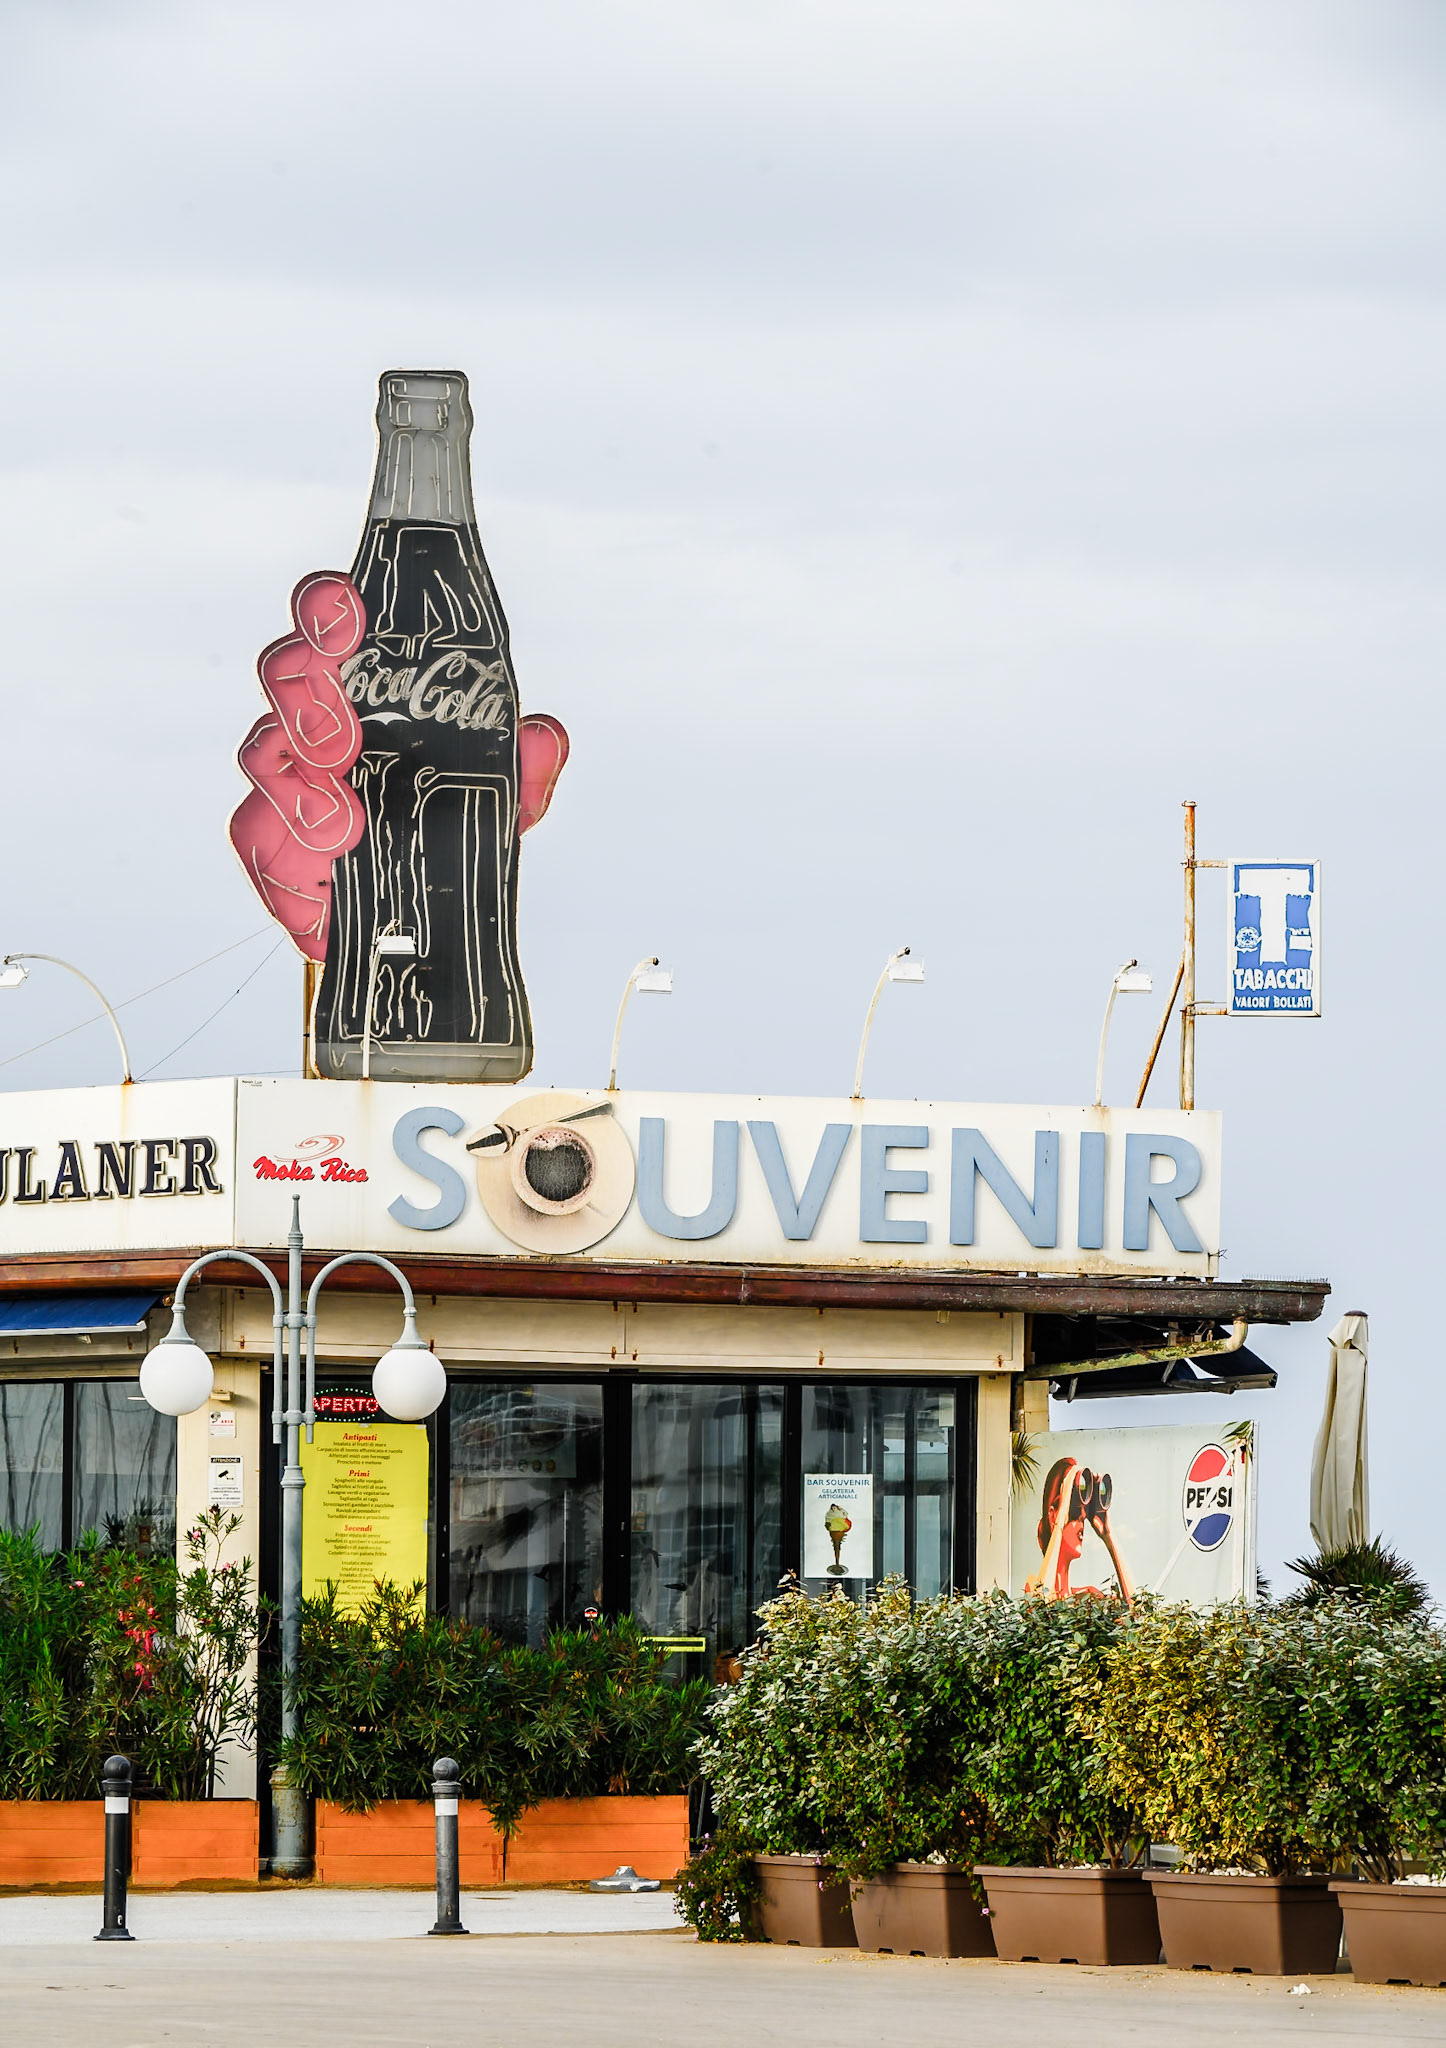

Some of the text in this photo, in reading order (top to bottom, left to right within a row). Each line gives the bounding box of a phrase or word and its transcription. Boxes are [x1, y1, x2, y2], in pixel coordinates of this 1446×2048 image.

[1234, 968, 1313, 991] TABACCHI
[1234, 995, 1312, 1008] VALORI BOLLATI
[253, 1155, 369, 1182] Moka Rica
[312, 1396, 380, 1413] APERTO
[343, 1433, 377, 1441] Antipasti
